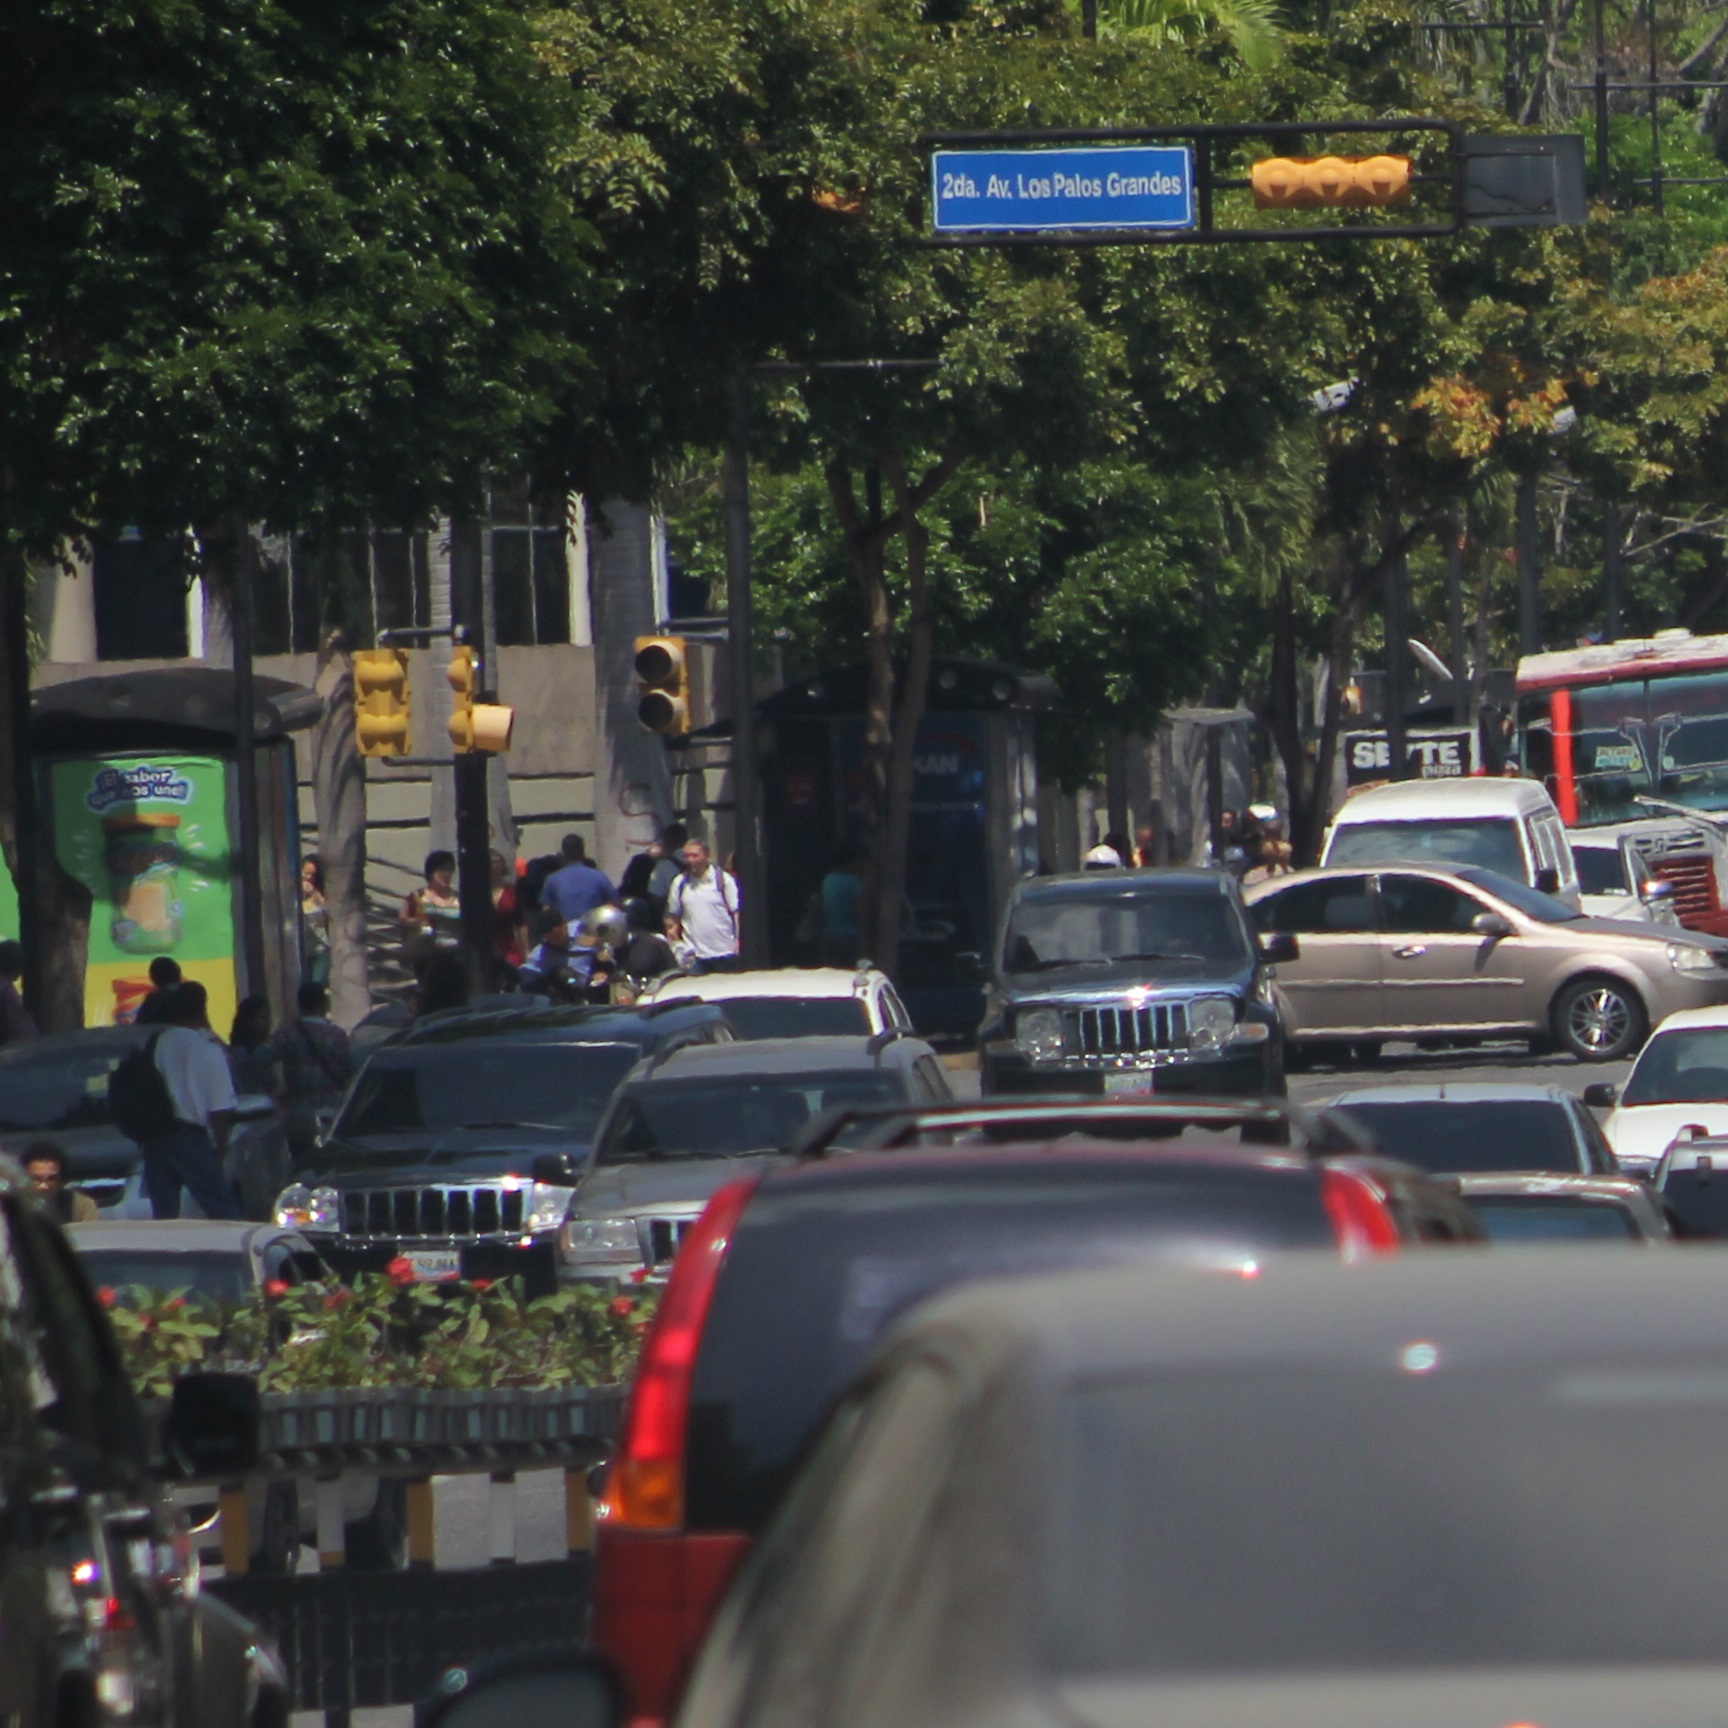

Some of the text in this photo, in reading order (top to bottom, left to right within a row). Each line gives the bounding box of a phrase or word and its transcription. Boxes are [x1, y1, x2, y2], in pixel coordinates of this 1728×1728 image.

[942, 170, 1182, 200] 2da. Av. Los Palos Grandes
[124, 767, 170, 784] sabor
